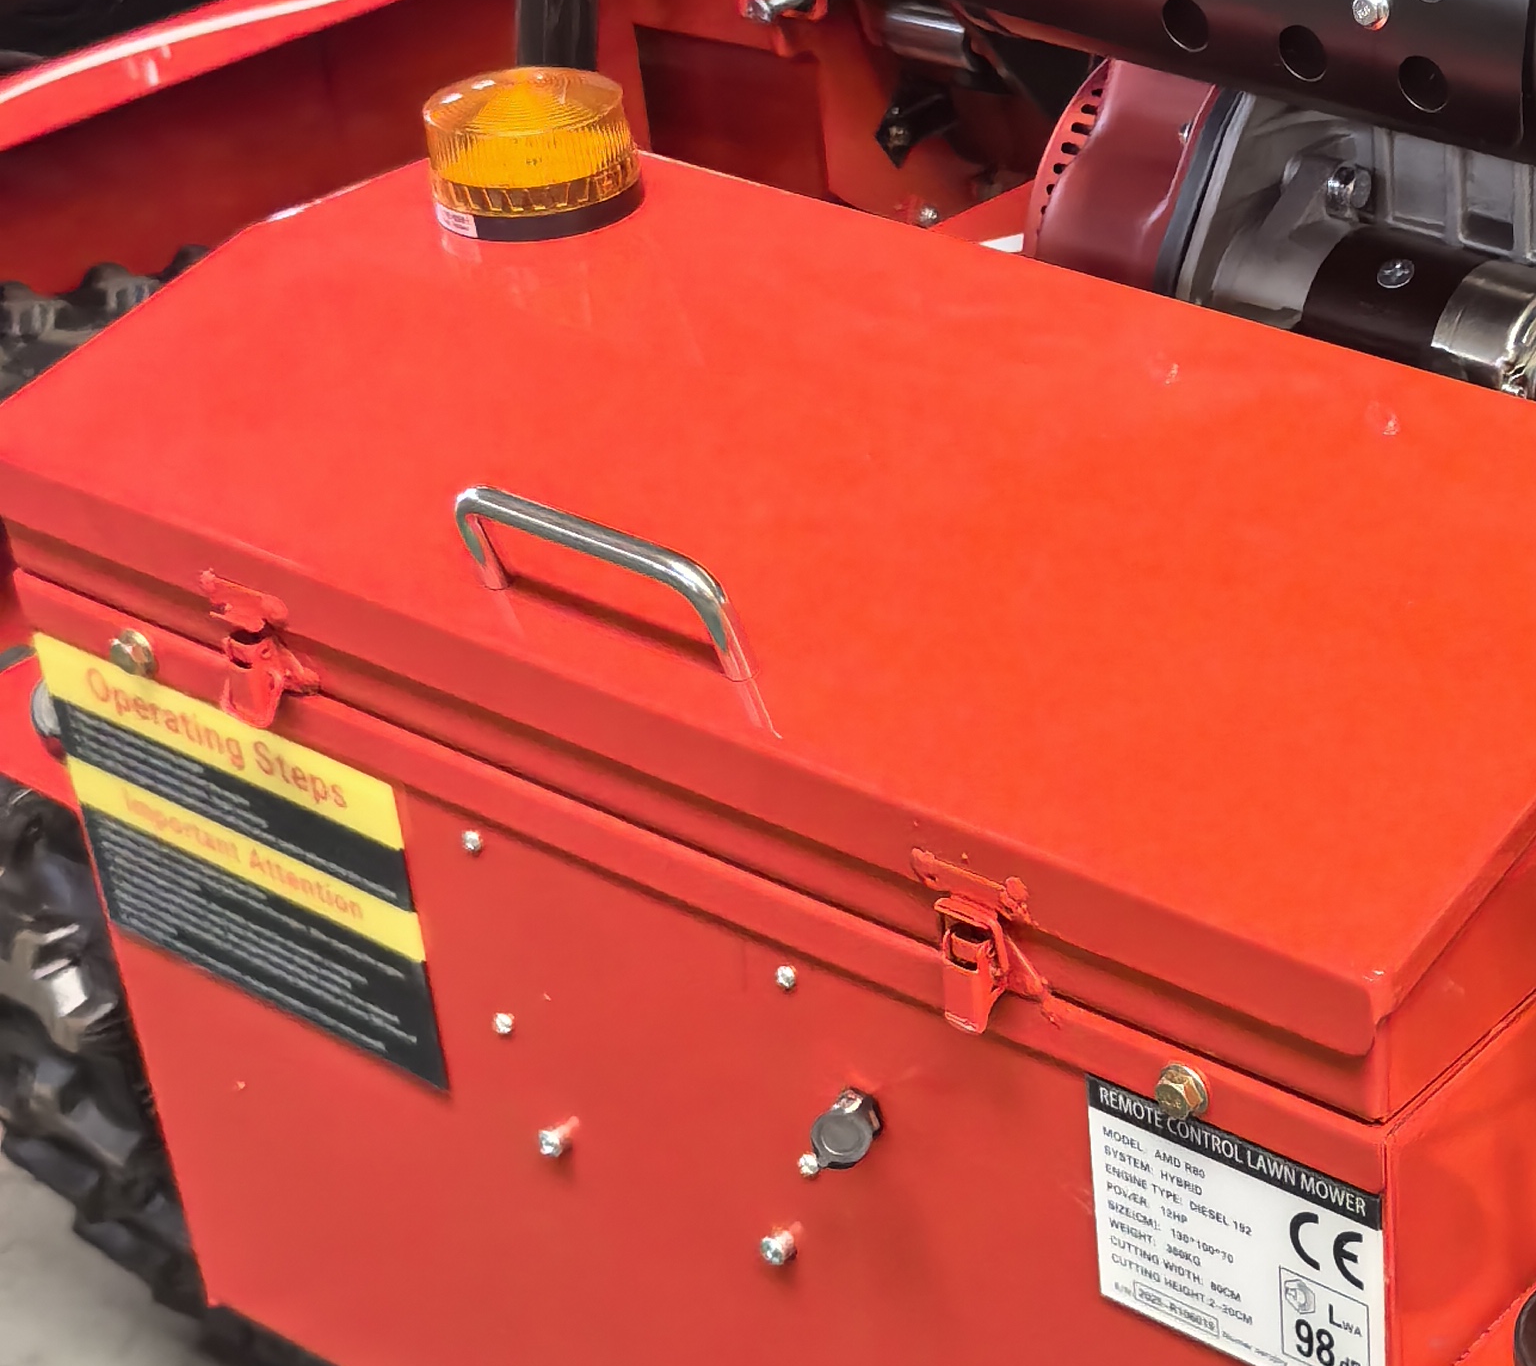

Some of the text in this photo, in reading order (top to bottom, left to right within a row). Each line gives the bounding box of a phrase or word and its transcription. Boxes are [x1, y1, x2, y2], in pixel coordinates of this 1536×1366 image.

[87, 667, 246, 771] Operating
[254, 740, 348, 809] Steps
[122, 786, 364, 920] Important Attention
[1099, 1086, 1367, 1217] REMOTE CONTROL LAWN MOWER
[1154, 1149, 1181, 1168] AMD
[1160, 1169, 1203, 1196] HYBRID
[1105, 1163, 1147, 1190] ENGINE
[1189, 1200, 1229, 1226] DIESEL
[1109, 1235, 1159, 1266] CUTTING
[1111, 1252, 1161, 1283] CUTTING
[1289, 1211, 1364, 1291] CE
